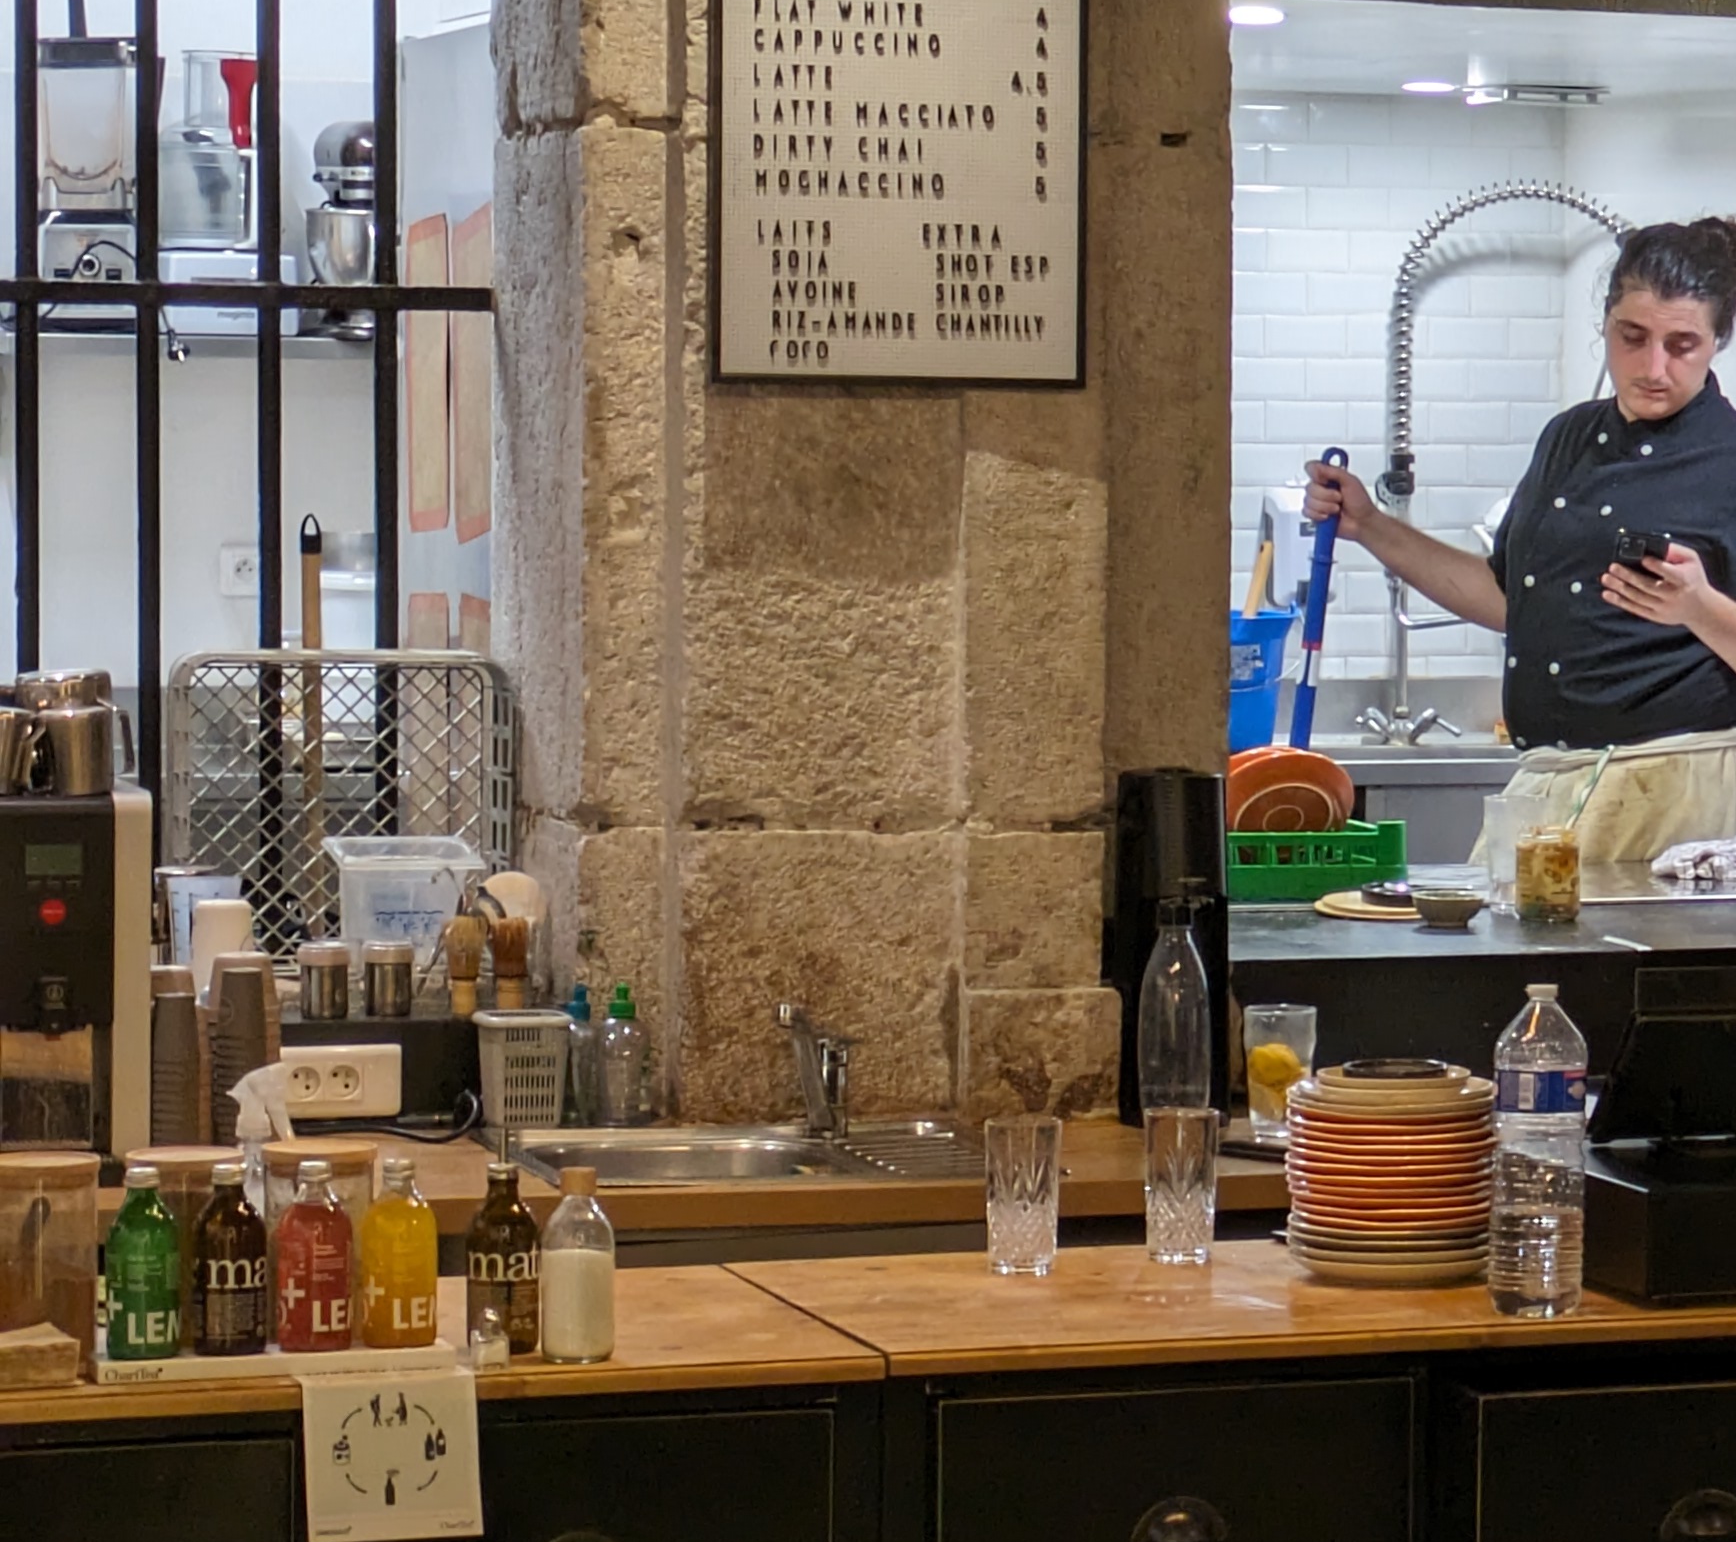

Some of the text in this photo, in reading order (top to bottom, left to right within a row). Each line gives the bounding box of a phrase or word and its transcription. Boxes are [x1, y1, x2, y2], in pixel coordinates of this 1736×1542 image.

[837, 0, 923, 28] WHITE
[1035, 7, 1049, 31] 4
[753, 27, 1049, 60] CAPPUCCINO 4
[753, 62, 1049, 96] LATTE 4.5
[753, 97, 1048, 131] LATTE MACCIATO 5
[753, 133, 1048, 165] DIRTY CHAI 5
[1034, 176, 1048, 201] 5
[757, 219, 831, 244] LAITS
[922, 222, 1001, 247] EXTRA
[935, 253, 1050, 279] SHOT ESP
[772, 280, 856, 306] AVOINE
[935, 283, 1005, 307] SIROP
[771, 310, 916, 337] RIZ-AMANDE
[935, 313, 1044, 338] CHANTILLY
